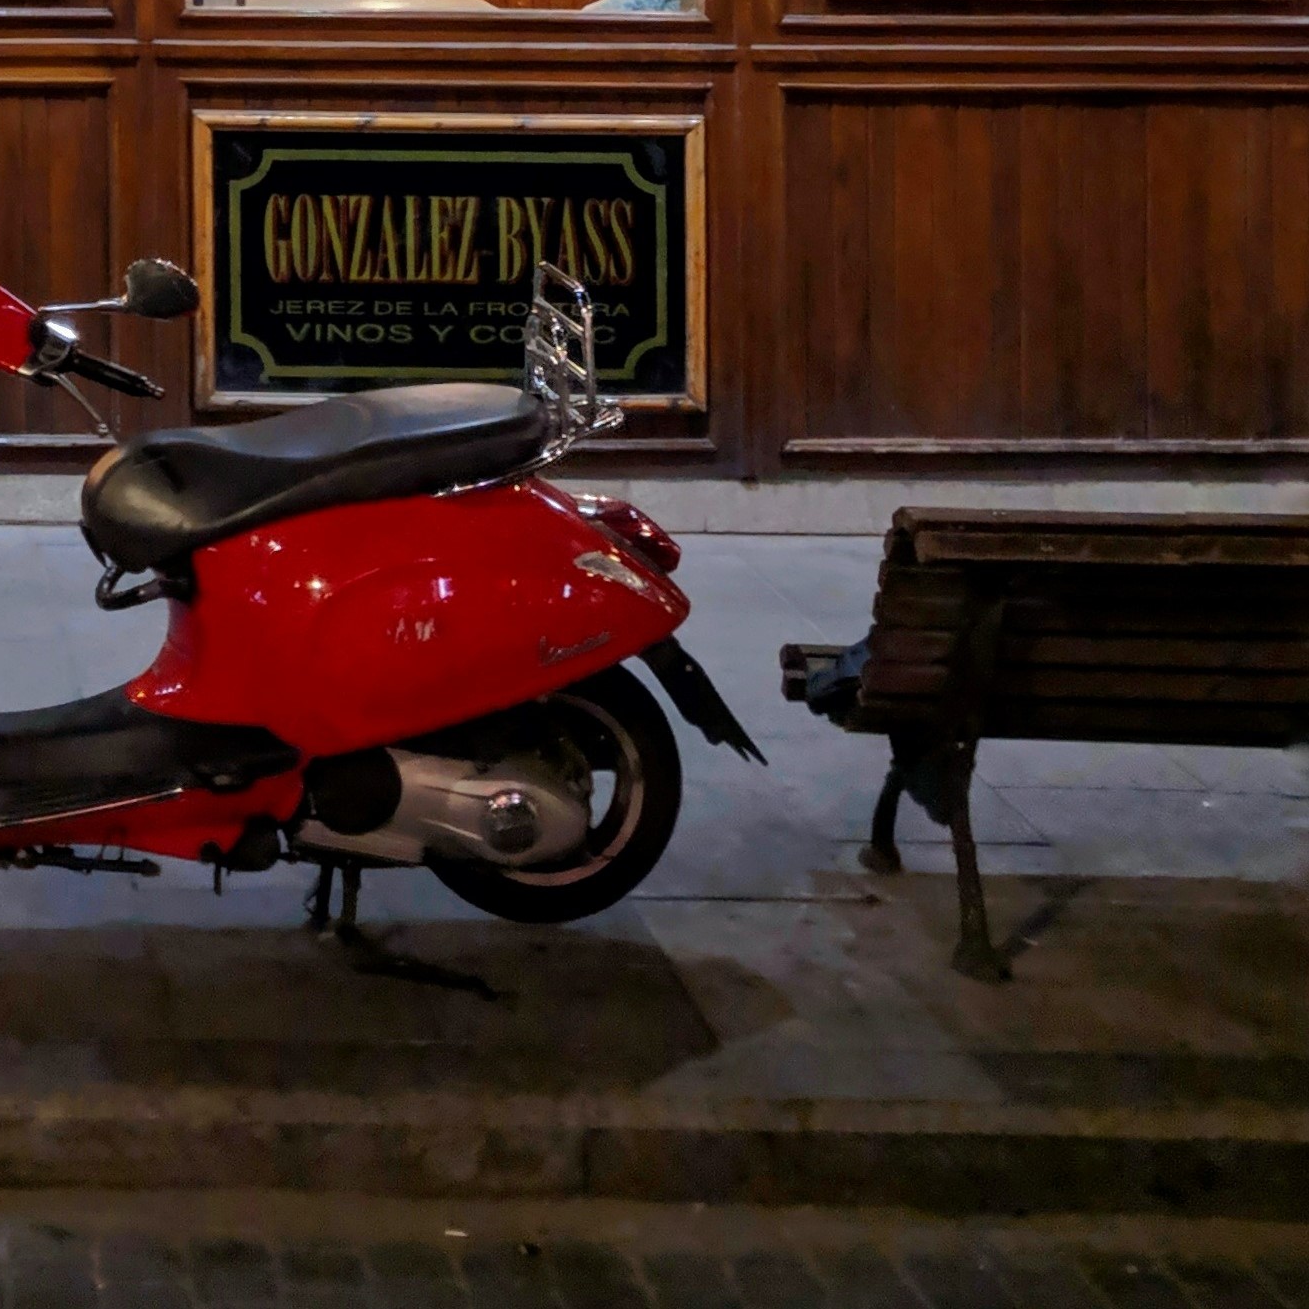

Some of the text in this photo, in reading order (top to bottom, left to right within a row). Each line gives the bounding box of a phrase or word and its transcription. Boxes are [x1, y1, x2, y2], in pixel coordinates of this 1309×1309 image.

[269, 299, 366, 317] JEREZ
[373, 300, 413, 317] DE
[423, 300, 459, 317] LA
[284, 322, 618, 345] VINOS Y COC
